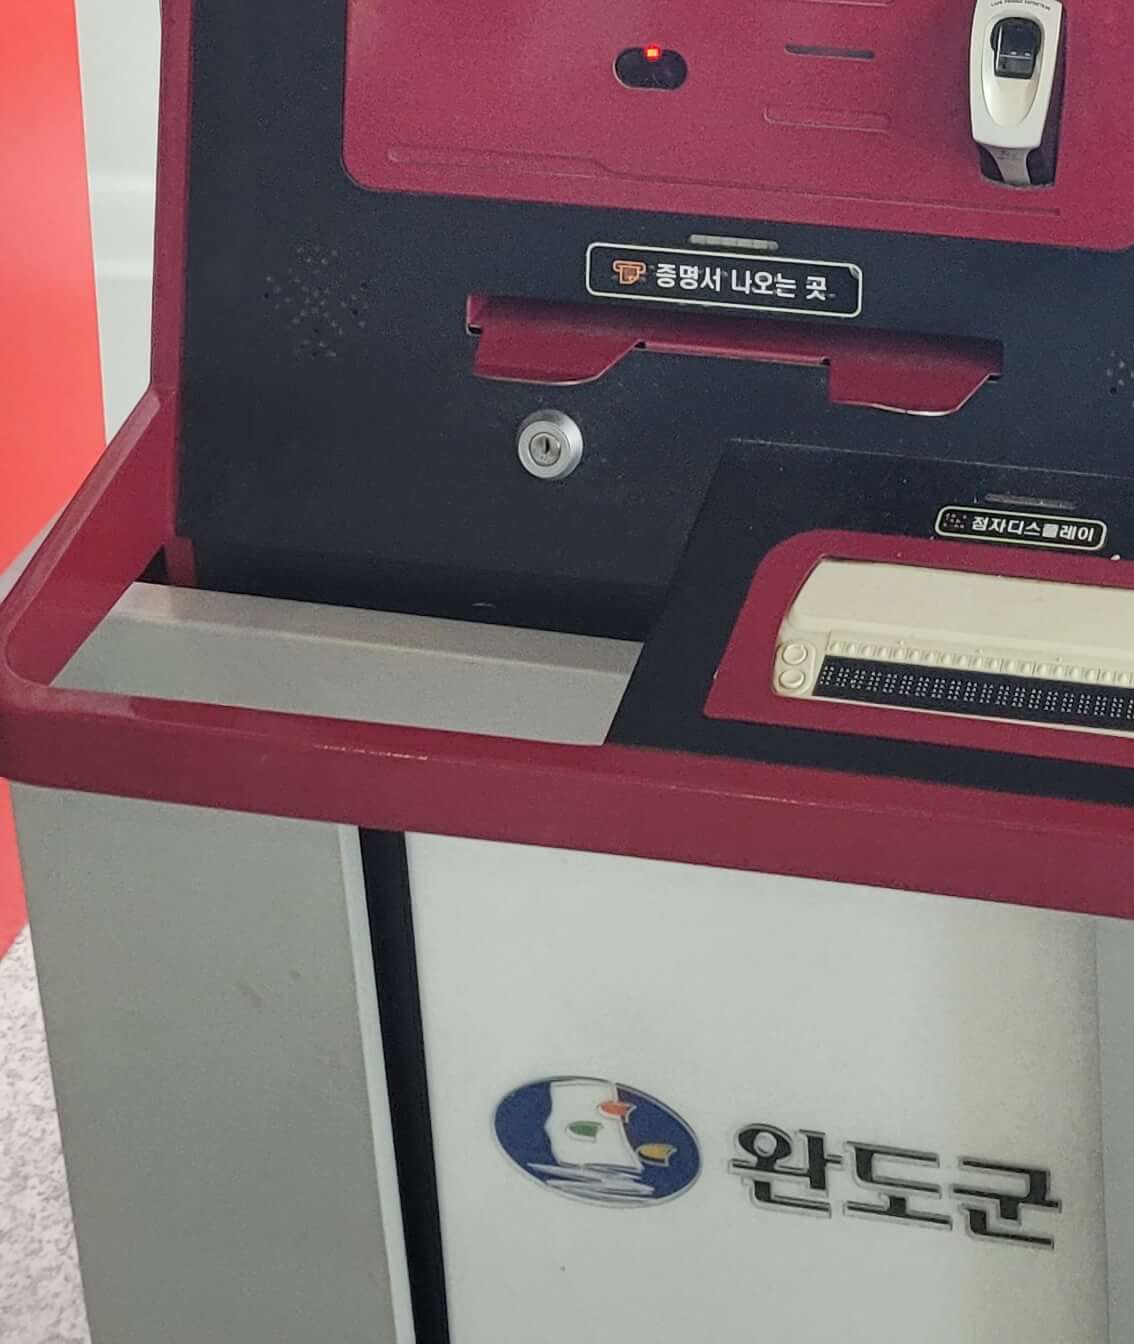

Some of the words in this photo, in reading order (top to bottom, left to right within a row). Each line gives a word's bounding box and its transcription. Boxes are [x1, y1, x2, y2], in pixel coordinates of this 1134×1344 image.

[655, 263, 721, 292] 증명서
[731, 269, 797, 299] 나오는
[805, 275, 828, 301] 곳
[972, 515, 1095, 544] 점자디스플레이
[727, 1122, 1063, 1251] 완도군
